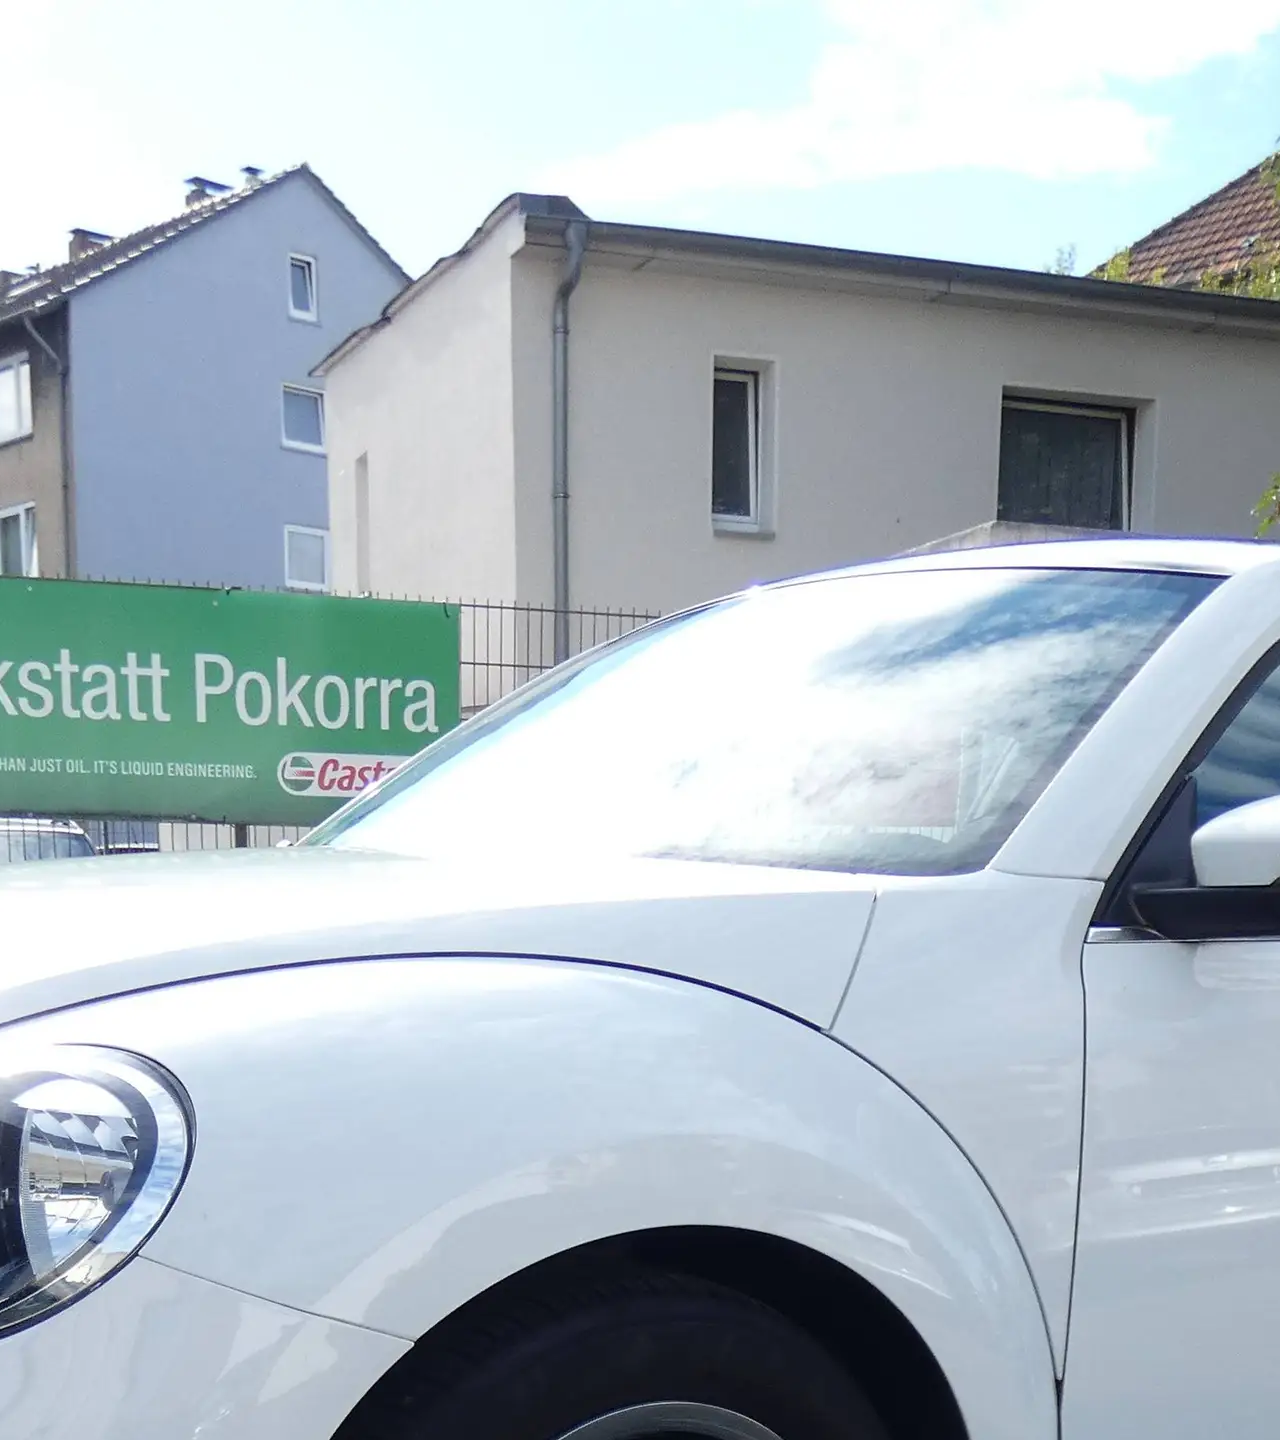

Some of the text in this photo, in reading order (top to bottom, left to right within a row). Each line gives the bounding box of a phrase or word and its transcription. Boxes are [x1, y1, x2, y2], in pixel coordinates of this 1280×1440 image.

[194, 652, 439, 734] Pokorra
[29, 758, 62, 773] JUST
[65, 759, 91, 774] OIL.
[93, 760, 118, 775] IT'S
[121, 761, 164, 776] LIQUID
[167, 762, 258, 779] ENGINEERING.
[317, 757, 397, 792] Cast
